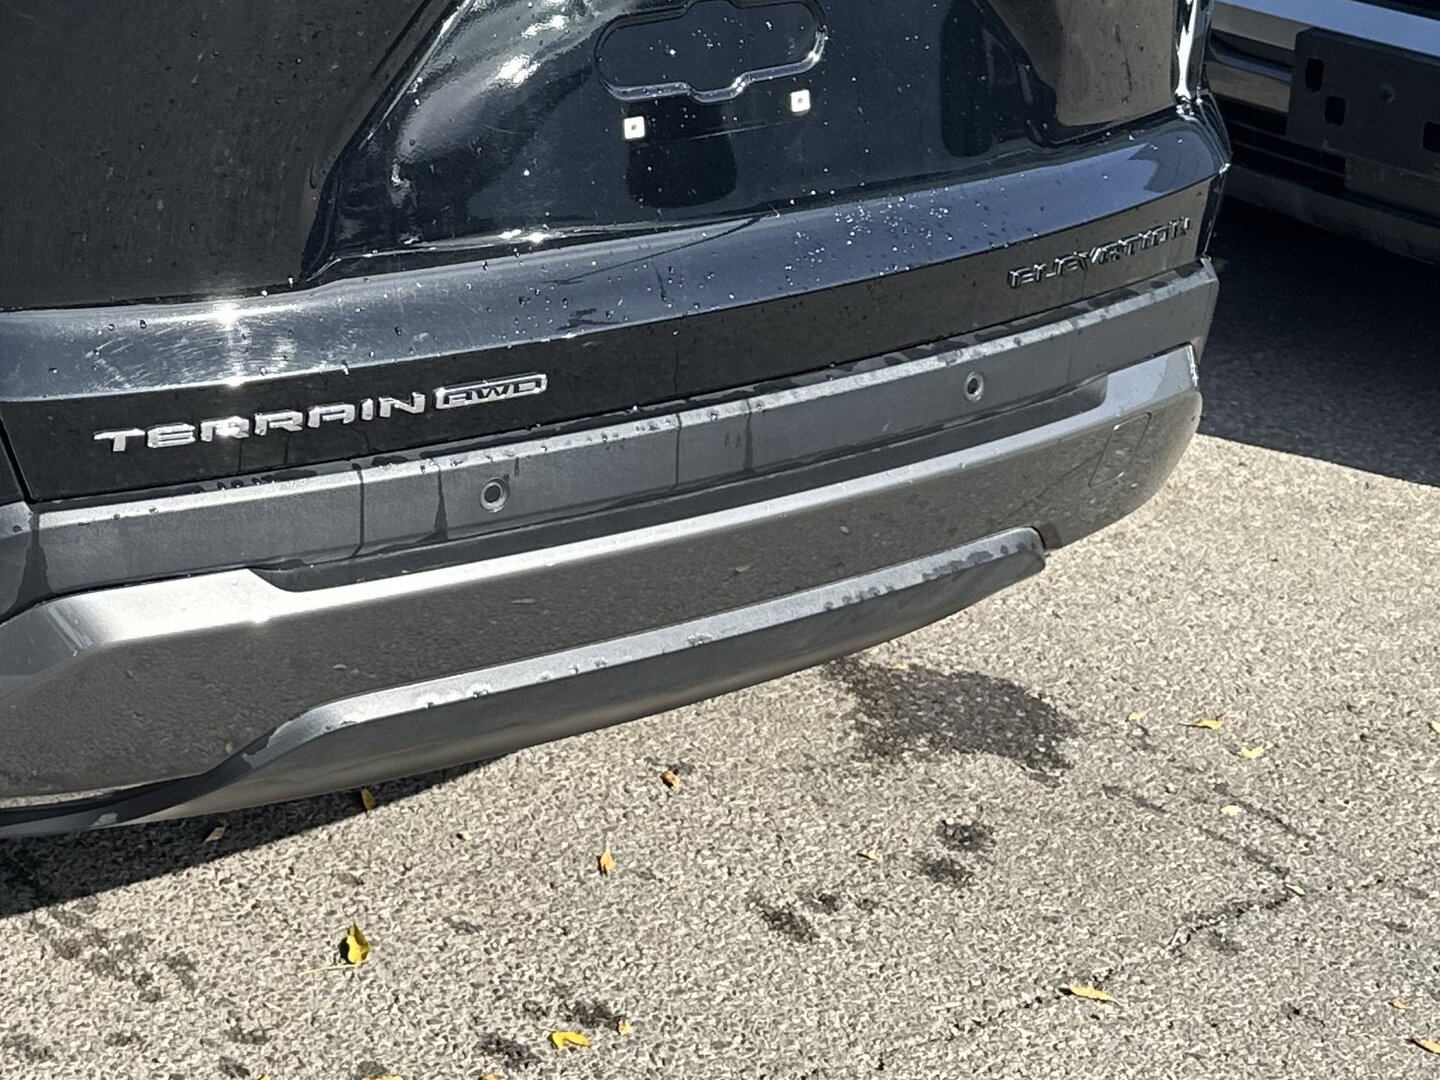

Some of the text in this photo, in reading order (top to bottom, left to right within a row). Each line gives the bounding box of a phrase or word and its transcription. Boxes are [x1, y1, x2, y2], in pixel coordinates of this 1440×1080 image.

[1007, 216, 1190, 289] ELEVATION
[93, 375, 544, 452] TERRAIN AWD
